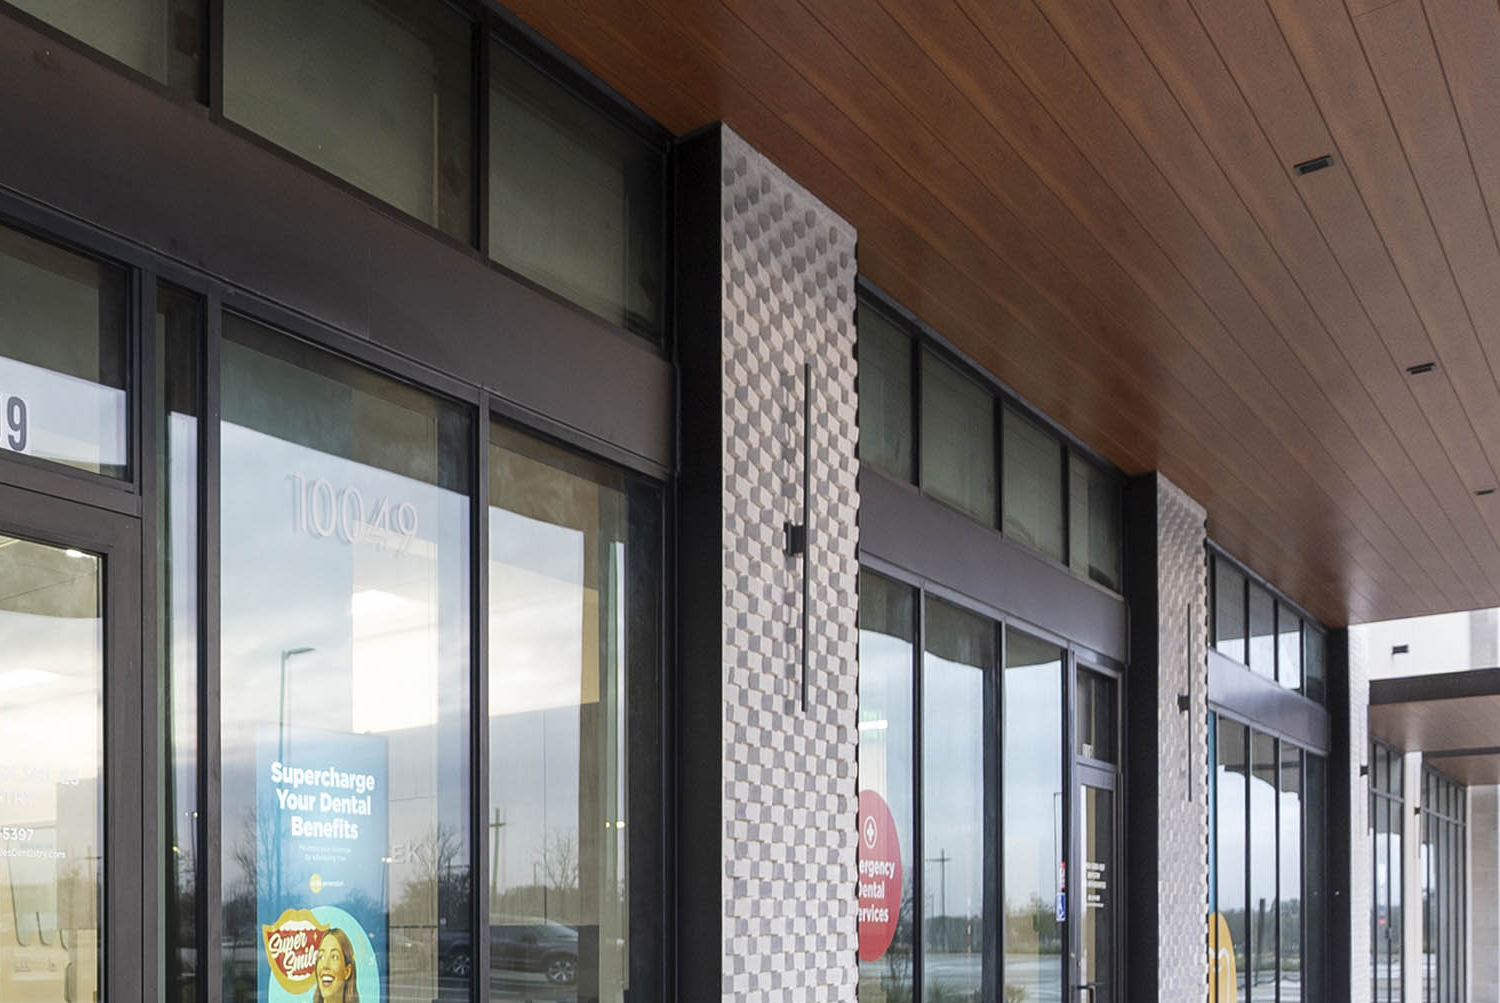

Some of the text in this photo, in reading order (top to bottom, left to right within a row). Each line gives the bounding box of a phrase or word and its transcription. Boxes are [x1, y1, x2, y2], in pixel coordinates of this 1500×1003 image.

[271, 761, 375, 794] Supercharge
[276, 788, 372, 816] Your Dental
[291, 816, 358, 839] Benefits
[269, 931, 307, 960] Super
